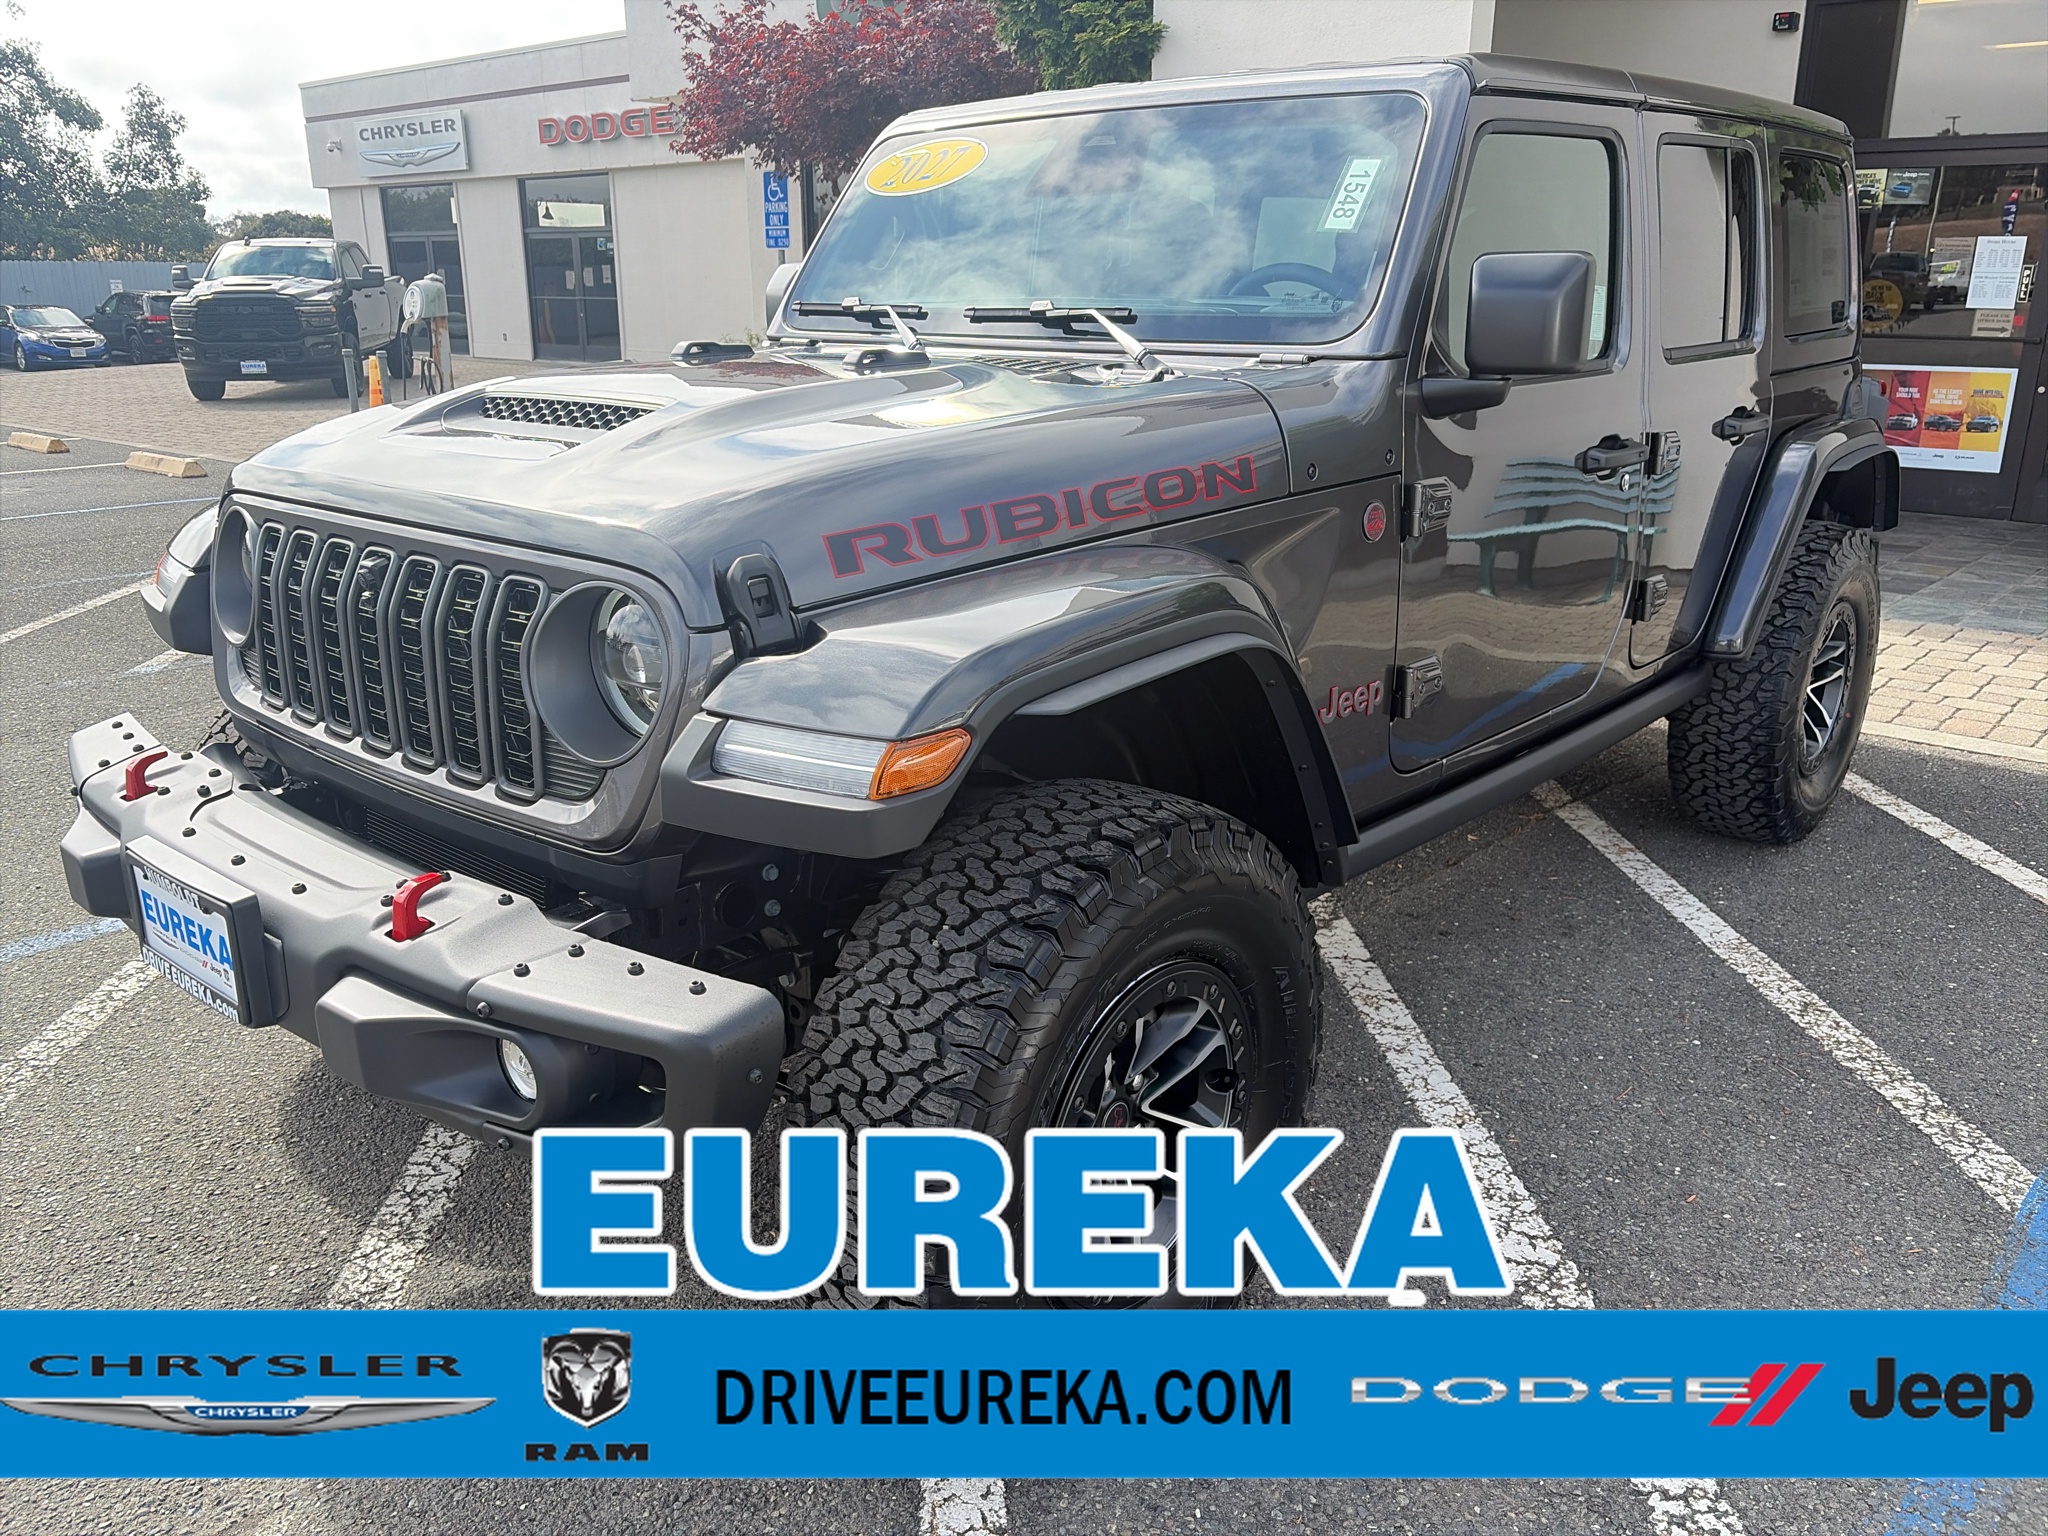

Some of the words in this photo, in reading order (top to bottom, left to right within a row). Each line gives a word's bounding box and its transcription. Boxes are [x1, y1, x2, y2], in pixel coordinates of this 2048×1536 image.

[359, 118, 457, 142] CHRYSLER
[538, 105, 676, 145] DODGE
[880, 145, 973, 189] 2027
[765, 202, 788, 213] PARKING
[1332, 170, 1372, 219] 1548
[769, 214, 784, 226] ONLY
[2019, 270, 2031, 299] PULL
[822, 455, 1257, 579] RUBICON
[1318, 680, 1384, 725] Jeep
[140, 888, 234, 971] EUREKA
